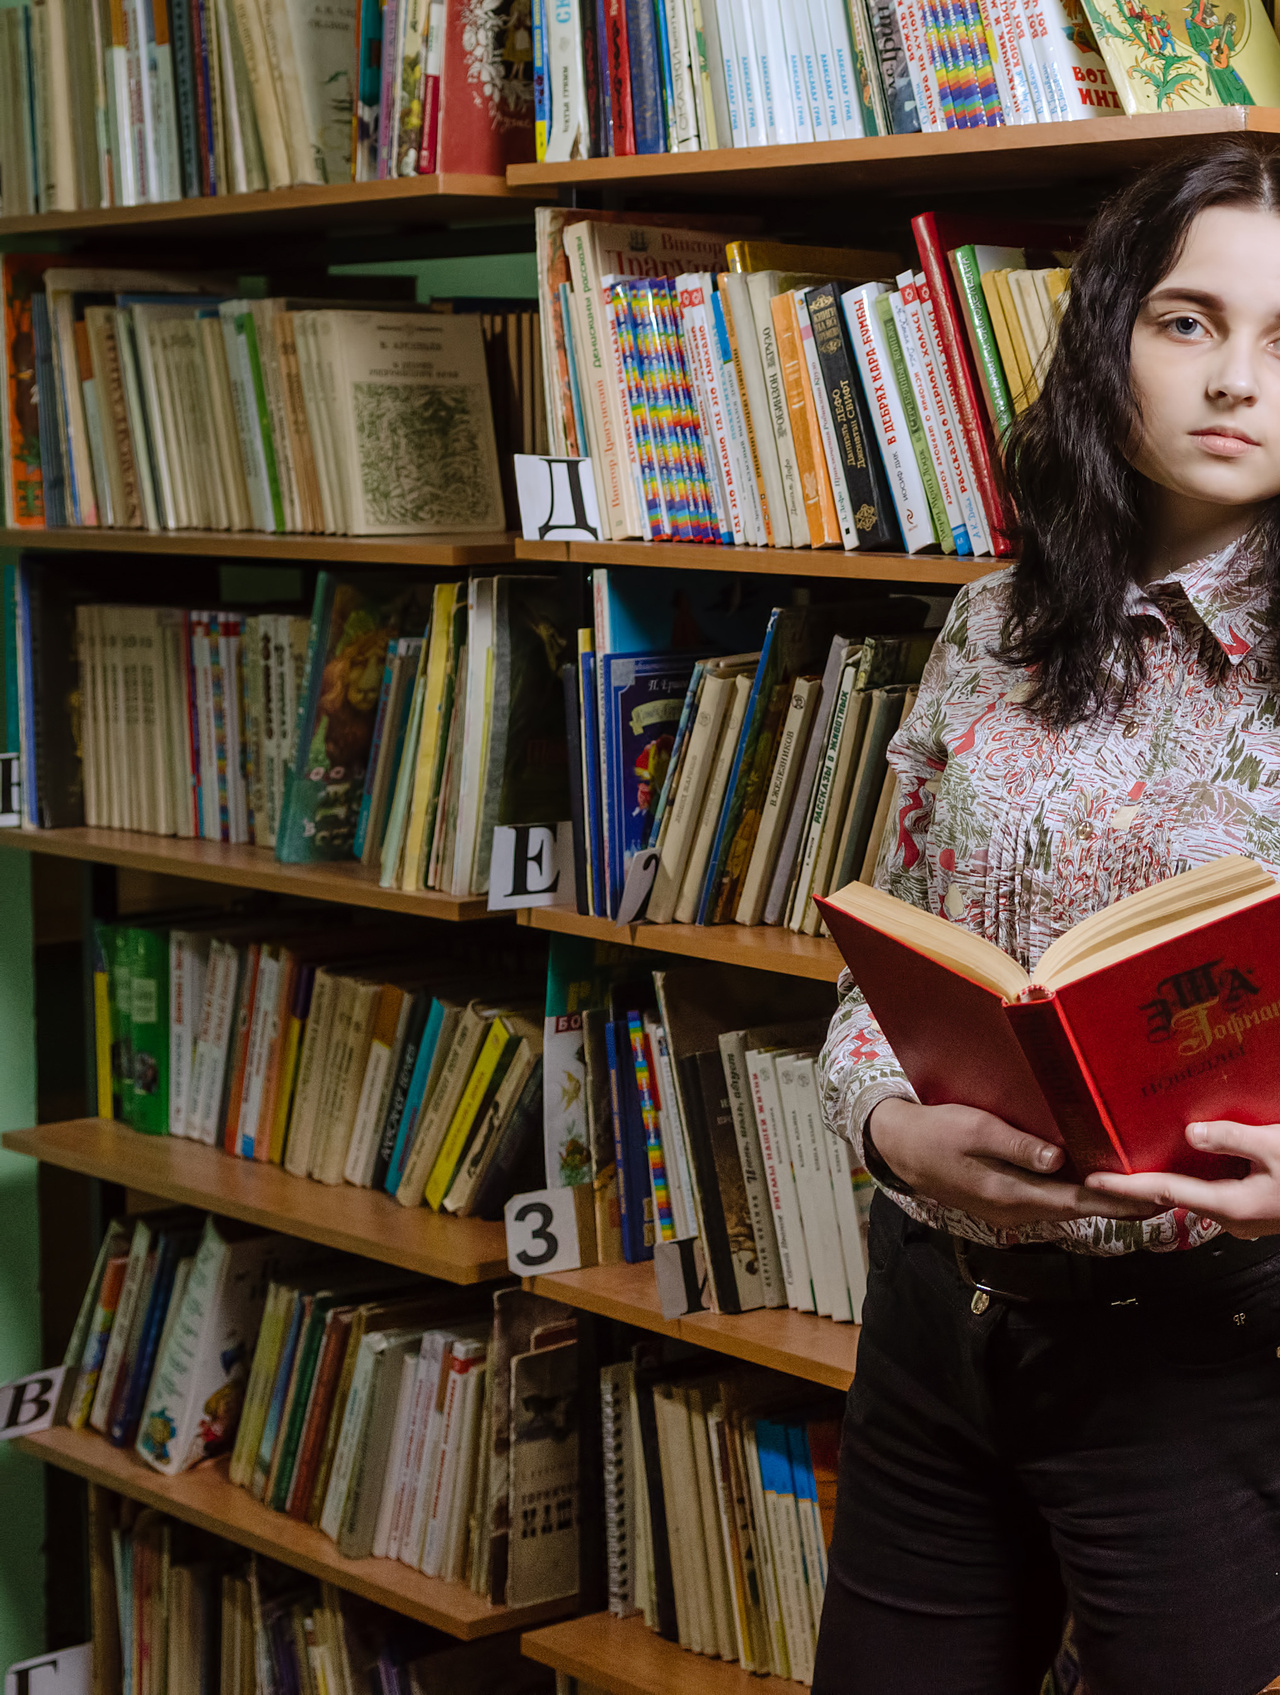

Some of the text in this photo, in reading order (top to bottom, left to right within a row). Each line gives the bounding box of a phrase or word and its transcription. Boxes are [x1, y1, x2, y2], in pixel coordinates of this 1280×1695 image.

[1072, 66, 1108, 84] ВОТ
[575, 235, 615, 456] Драгунский Денискины рассказы
[609, 319, 637, 464] ДЕНИСКИНЫ РАССКАЗЫ
[714, 410, 724, 431] ГДЕ
[768, 372, 787, 440] РОБИНЗОН
[832, 388, 847, 418] ДЕФО
[840, 379, 857, 419] СВИФТ
[854, 297, 911, 502] ИОСИФ ДИК В ДЕБРЯХ КАРА-БУМБЫ
[910, 309, 968, 494] РАССКАЗЫ ШЕРЛОКЕ ХОЛМСЕ
[539, 458, 599, 540] Д
[731, 512, 742, 534] ГДЕ
[773, 730, 795, 797] ЖЕЛЕЗНИКОВ
[813, 690, 849, 825] РАССКАЗЫ ЖИВОТНЫХ
[505, 824, 562, 898] Е
[5, 1376, 52, 1427] В
